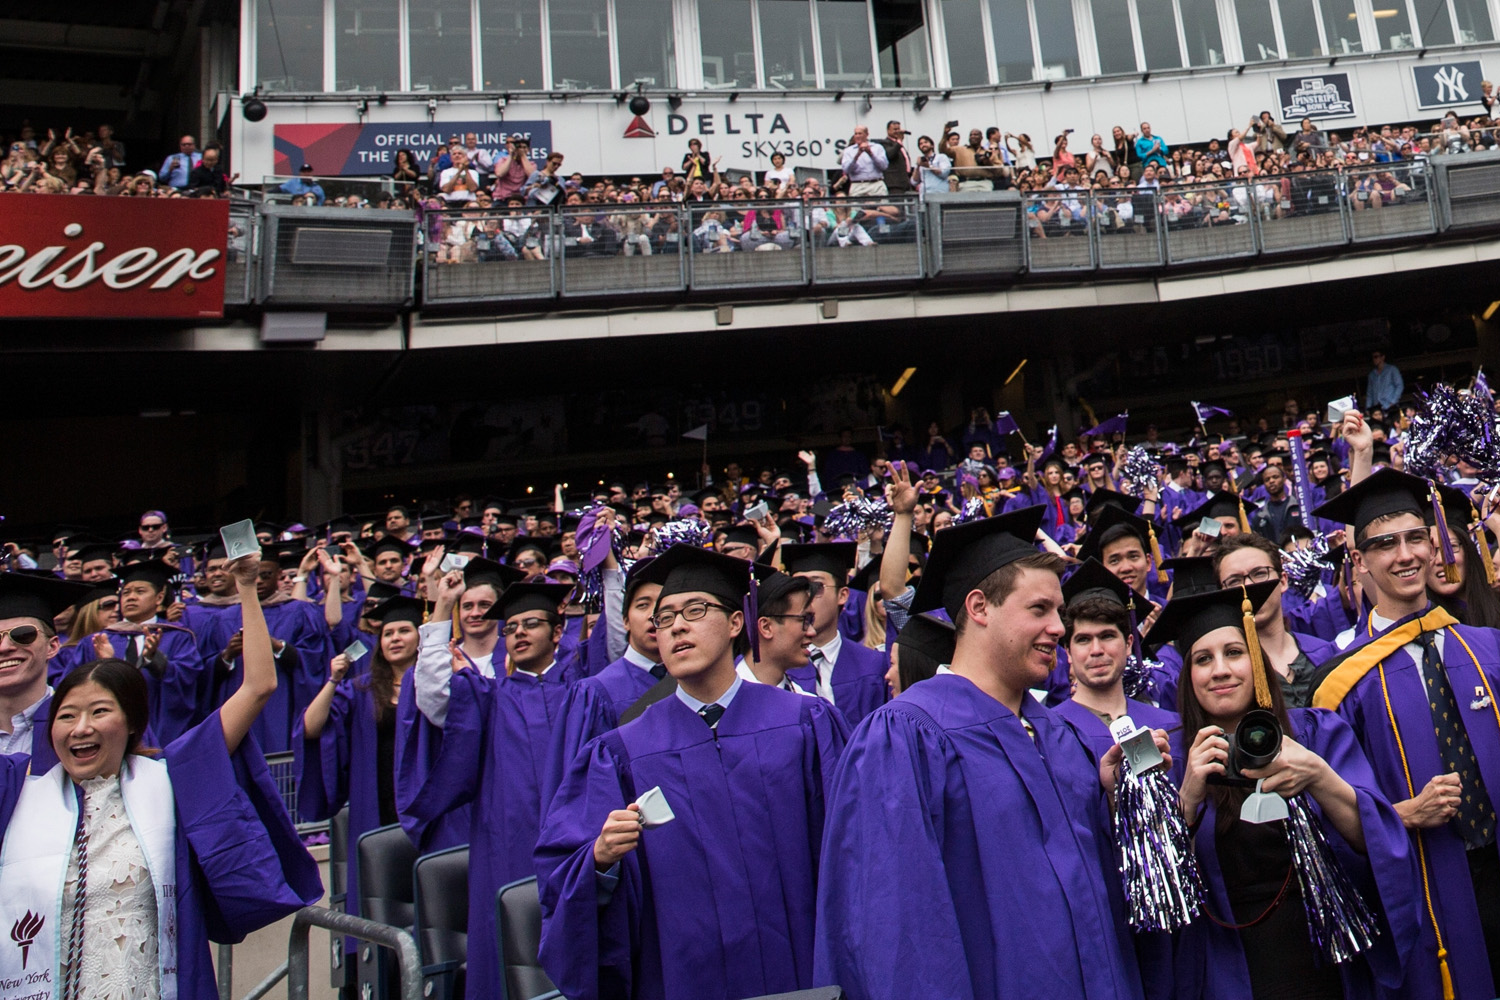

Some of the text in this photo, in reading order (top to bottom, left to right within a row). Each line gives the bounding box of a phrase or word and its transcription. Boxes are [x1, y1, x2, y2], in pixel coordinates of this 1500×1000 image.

[1433, 66, 1469, 102] NY
[668, 114, 791, 134] DELTA
[375, 134, 444, 146] OFFICIAL
[358, 151, 389, 162] THE
[1298, 486, 1309, 528] SCIENC
[0, 968, 51, 991] New York
